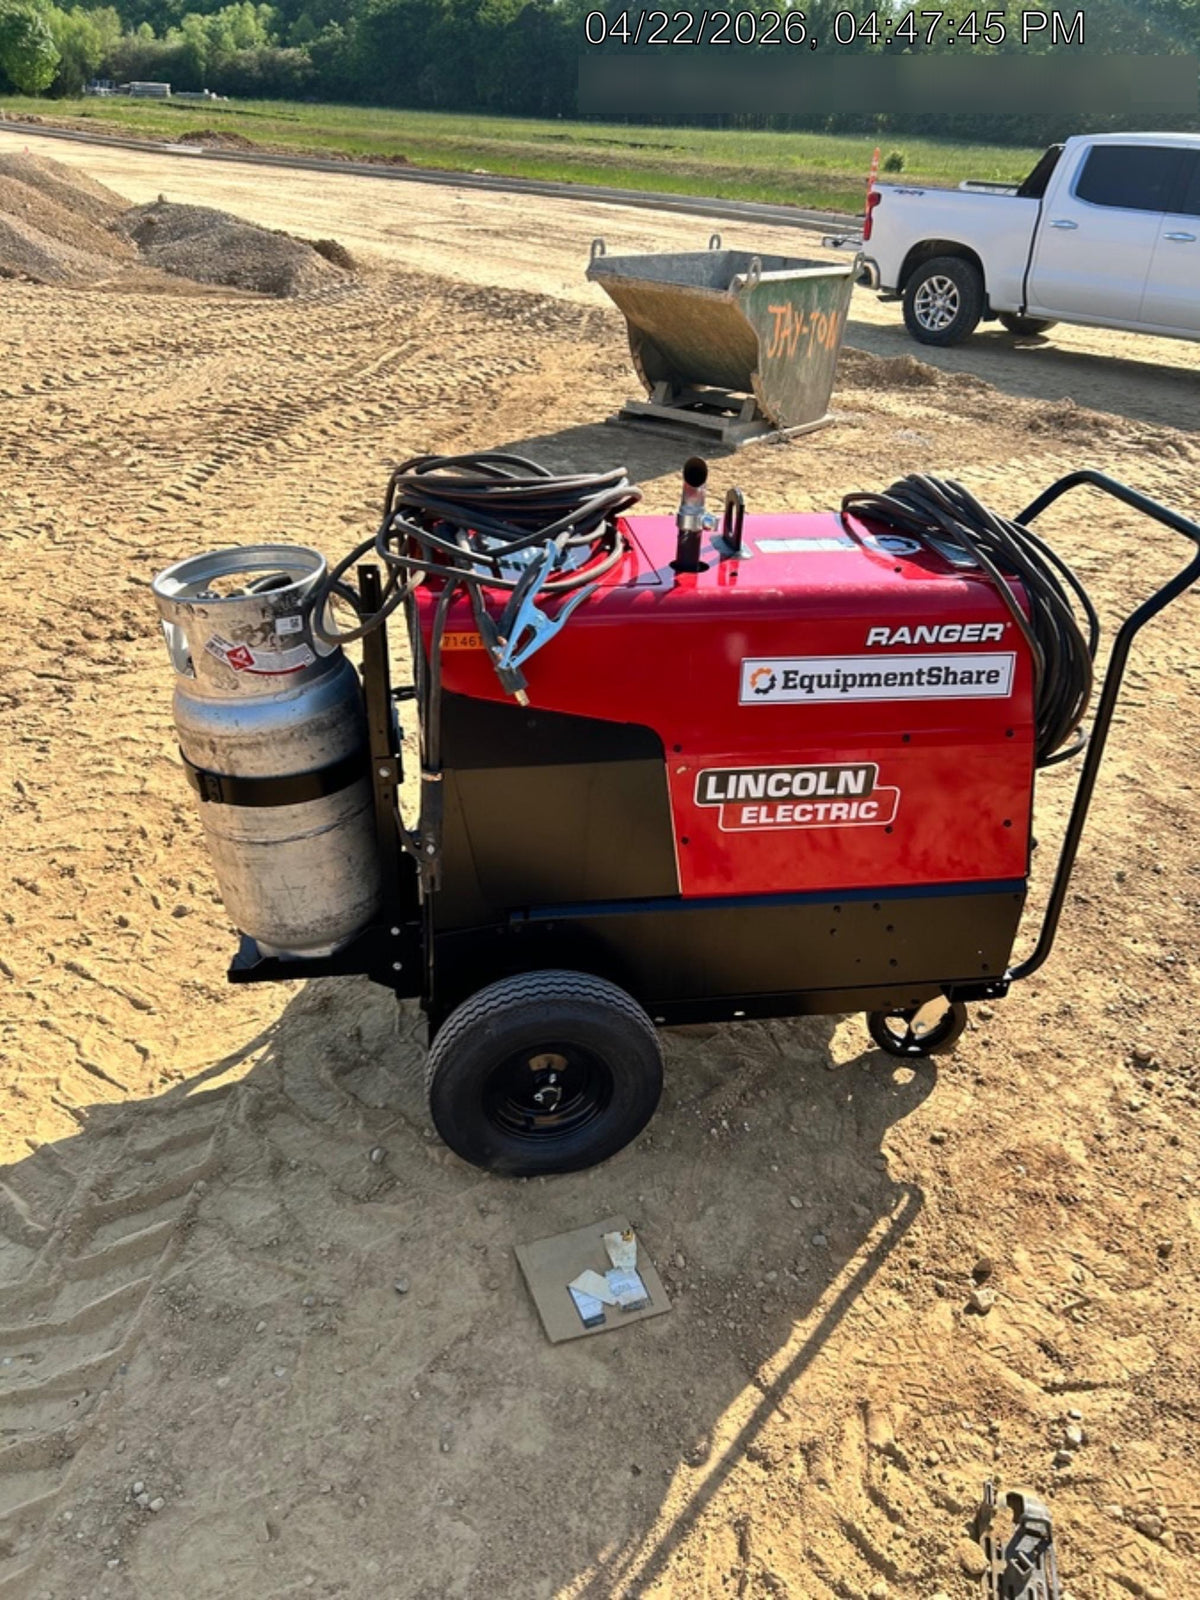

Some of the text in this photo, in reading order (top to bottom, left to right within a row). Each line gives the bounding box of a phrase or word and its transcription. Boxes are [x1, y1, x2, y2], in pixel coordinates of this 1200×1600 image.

[866, 623, 1004, 646] RANGER
[781, 667, 1001, 694] EquipmentShare
[707, 769, 865, 800] LINCOLN
[741, 801, 879, 825] ELECTRIC
